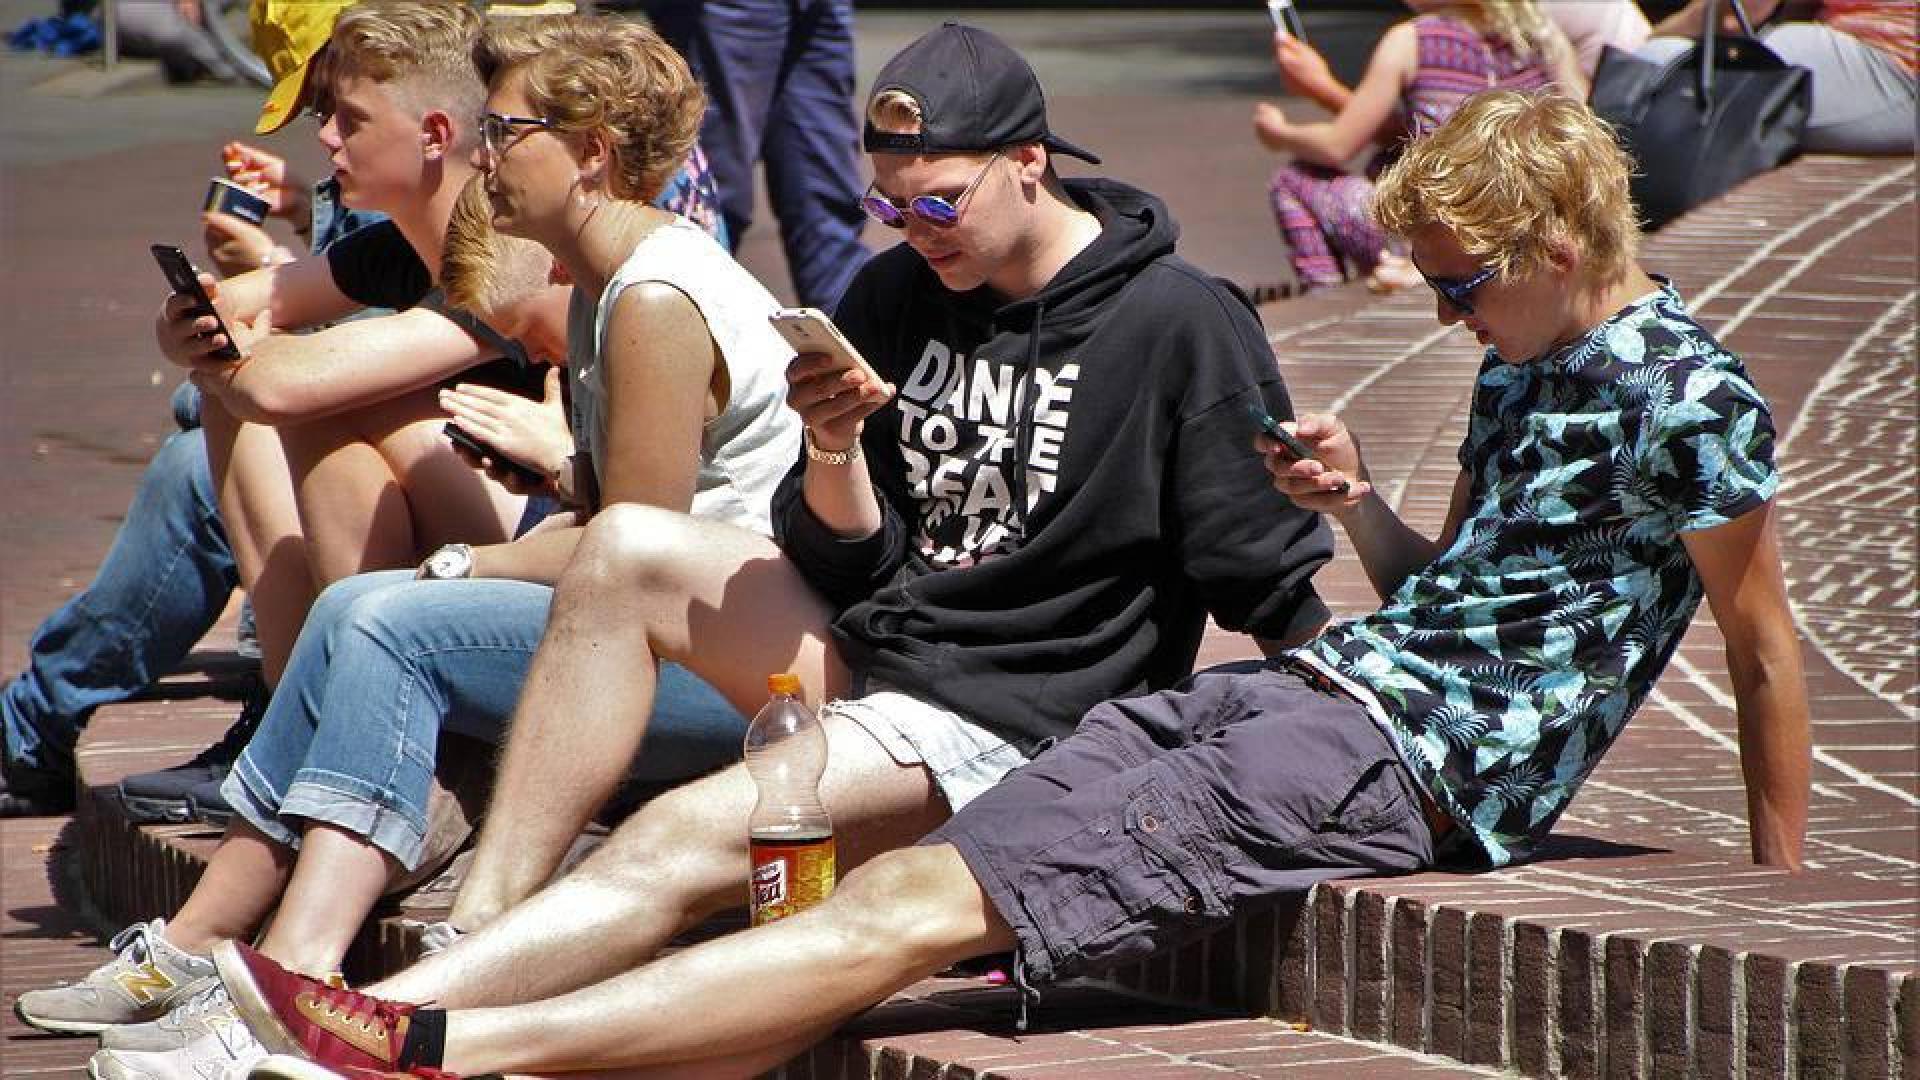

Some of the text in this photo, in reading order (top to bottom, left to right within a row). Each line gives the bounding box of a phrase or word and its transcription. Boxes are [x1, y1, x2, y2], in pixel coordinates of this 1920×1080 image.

[901, 339, 1080, 427] DANCE
[898, 398, 1065, 471] TO THE
[113, 963, 176, 1008] N
